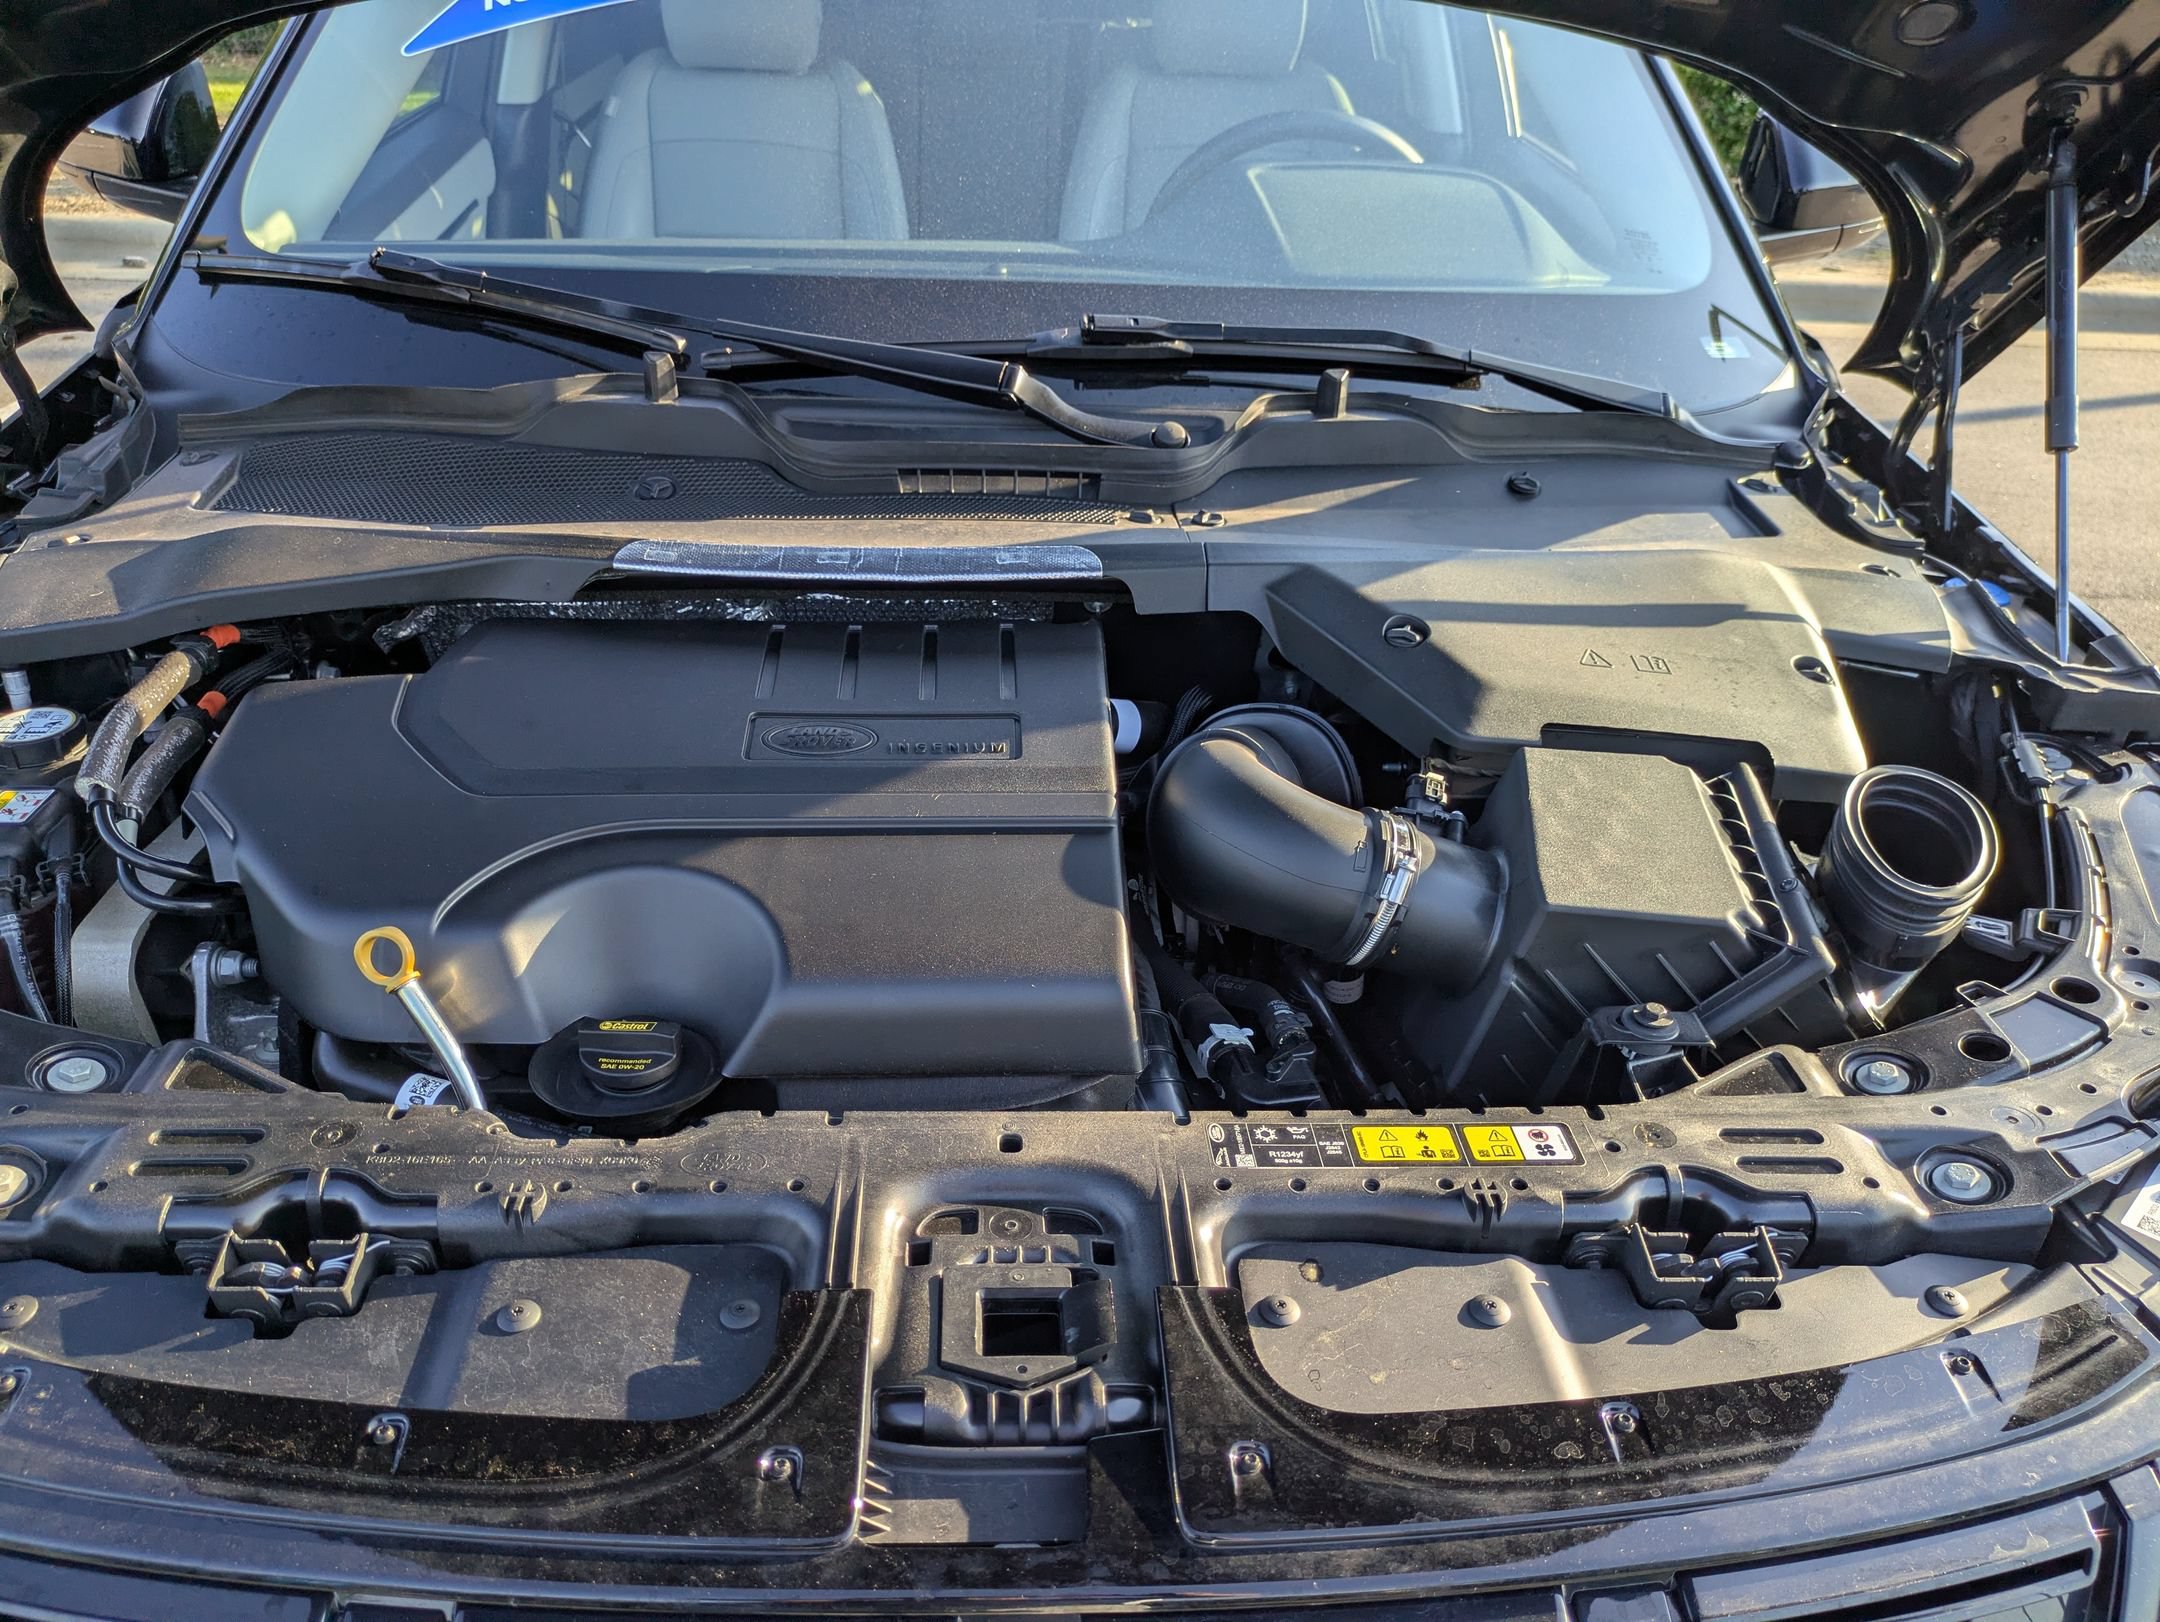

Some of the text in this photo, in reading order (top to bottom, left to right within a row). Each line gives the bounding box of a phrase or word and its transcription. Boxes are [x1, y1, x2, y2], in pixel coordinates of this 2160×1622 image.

[887, 742, 1006, 753] INGENIUM
[612, 1022, 649, 1031] Castrol
[1269, 1150, 1304, 1158] R1234yf
